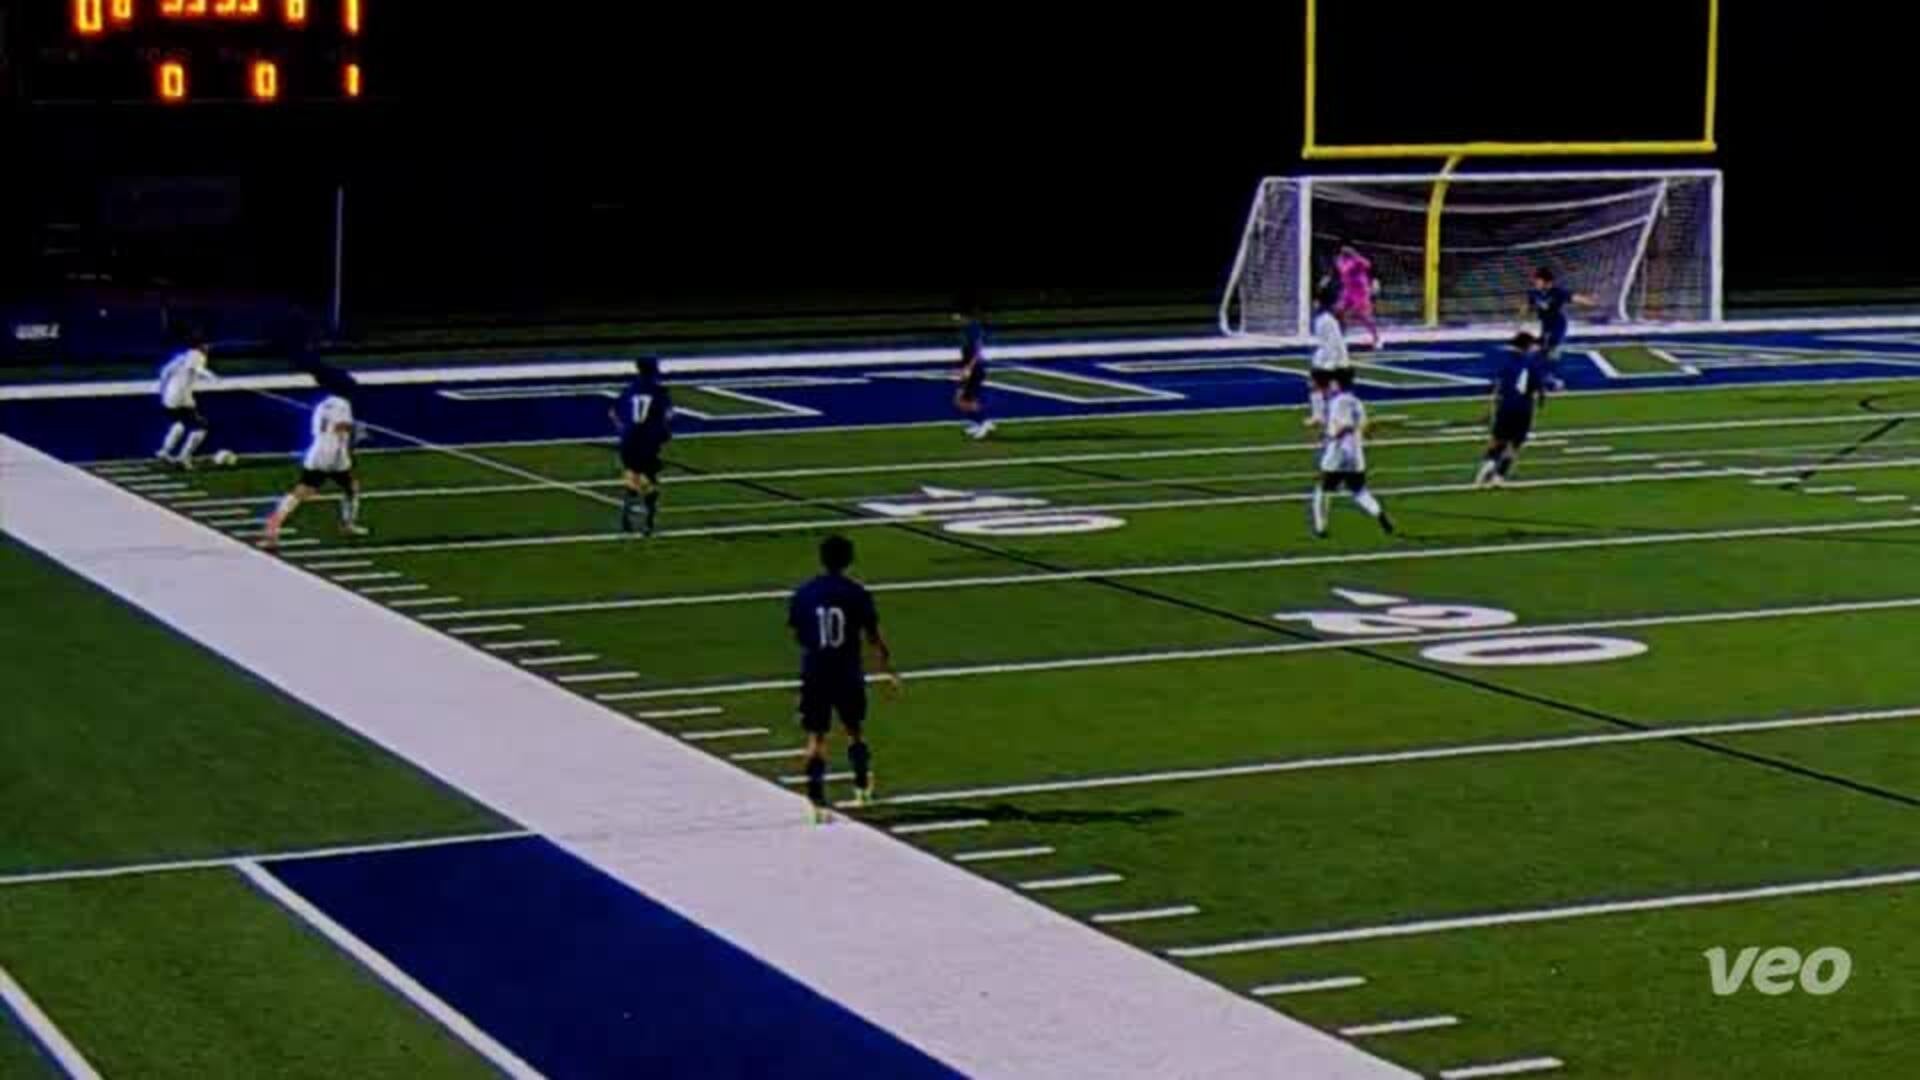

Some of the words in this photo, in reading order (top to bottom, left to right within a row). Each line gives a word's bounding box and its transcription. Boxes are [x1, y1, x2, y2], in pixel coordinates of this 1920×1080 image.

[162, 63, 185, 97] 0
[255, 62, 277, 97] 0
[347, 63, 360, 97] 1
[1515, 368, 1528, 395] 4
[631, 393, 653, 424] 17
[815, 605, 846, 648] 10
